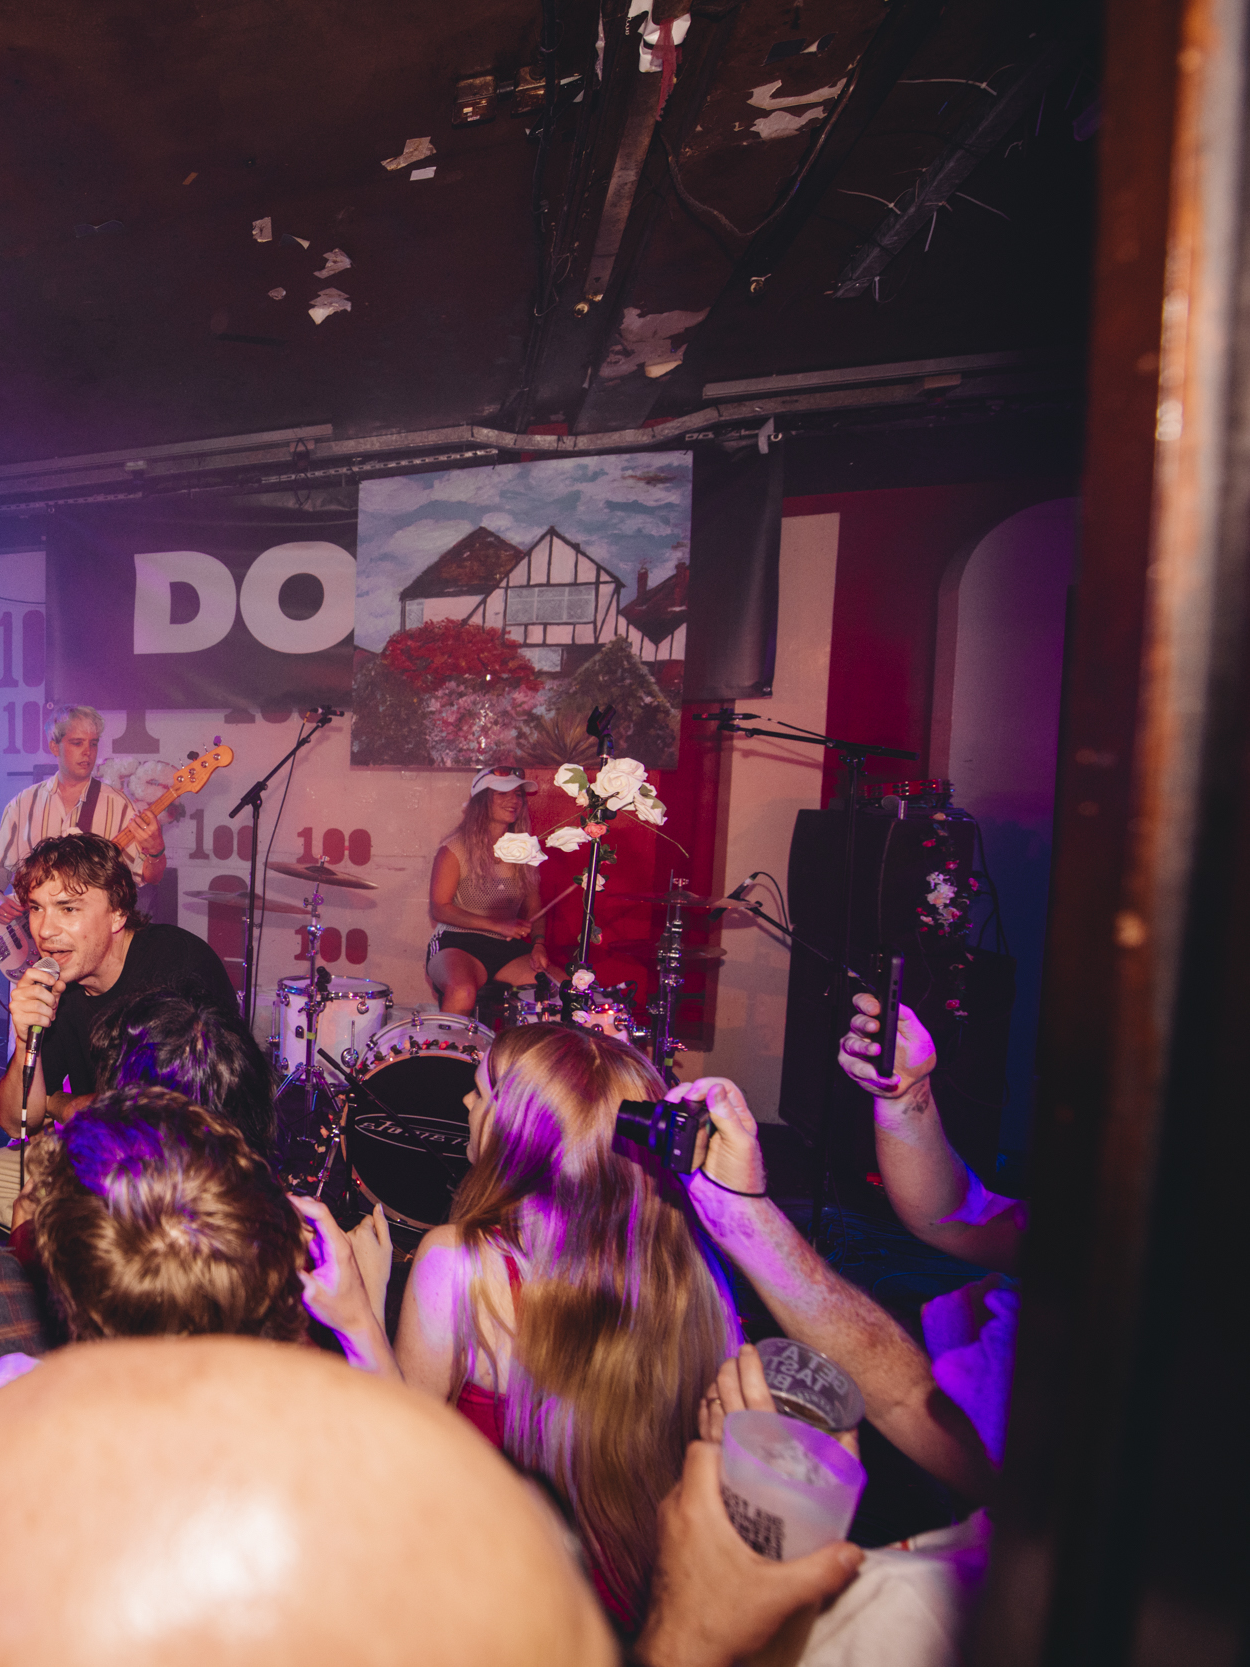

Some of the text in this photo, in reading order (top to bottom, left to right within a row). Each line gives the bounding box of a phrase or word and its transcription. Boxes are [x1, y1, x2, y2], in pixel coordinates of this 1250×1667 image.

[134, 541, 357, 654] DO
[296, 826, 372, 867] 100
[294, 924, 369, 965] 100
